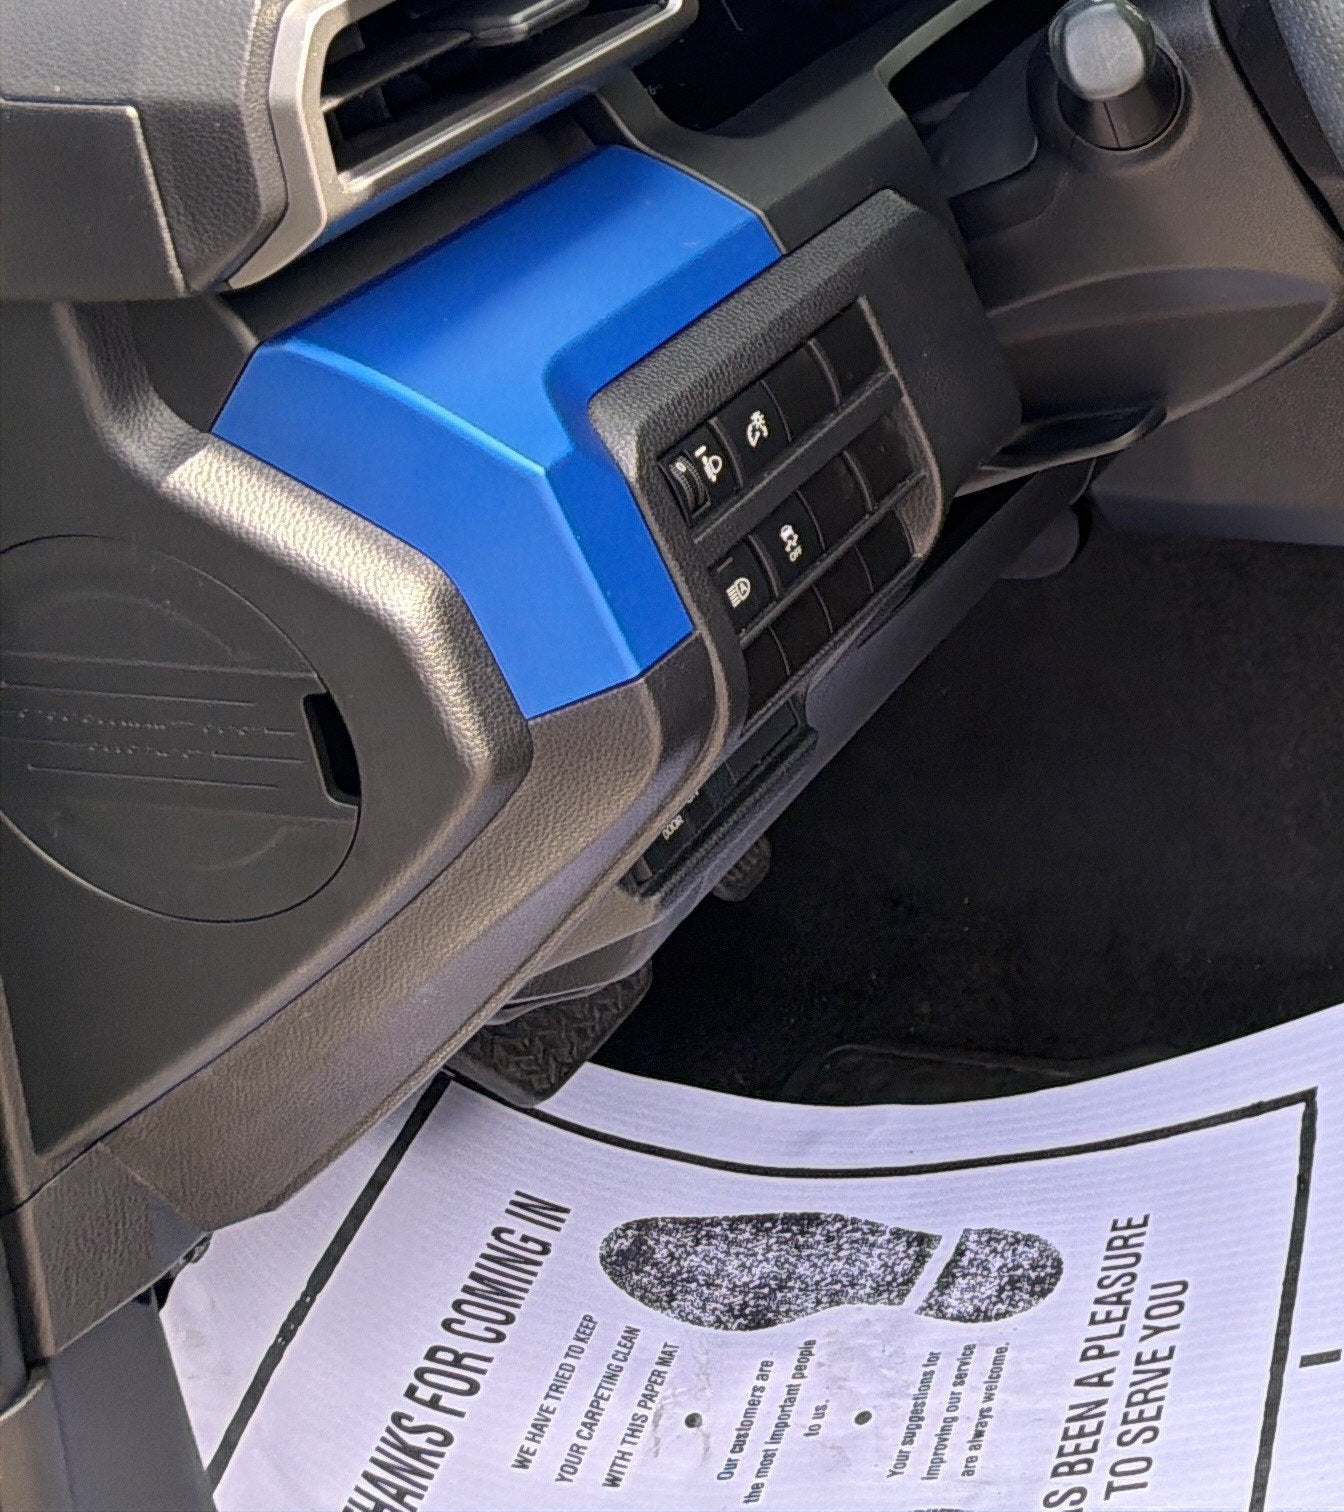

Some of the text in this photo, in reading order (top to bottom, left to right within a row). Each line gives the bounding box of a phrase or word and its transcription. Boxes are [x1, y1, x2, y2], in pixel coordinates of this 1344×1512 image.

[789, 545, 803, 563] OFF
[342, 1189, 571, 1512] HANKS FOR COMING IN
[1079, 1212, 1150, 1363] PLEASURE
[511, 1314, 598, 1470] WE HAVE TRIED TO KEEP
[554, 1325, 641, 1483] YOUR CARPETING CLEAN
[602, 1340, 680, 1488] WITH THIS PAPER MAT
[716, 1360, 774, 1480] Our customers are
[742, 1339, 817, 1504] the most important people
[803, 1399, 830, 1438] to us.
[886, 1351, 942, 1479] Your suggestions for
[945, 1390, 963, 1413] our
[952, 1343, 977, 1388] service
[961, 1341, 1010, 1478] are always welcome.
[1073, 1366, 1117, 1388] A
[1103, 1279, 1189, 1501] TO SERVE YOU
[1050, 1398, 1109, 1479] BEEN
